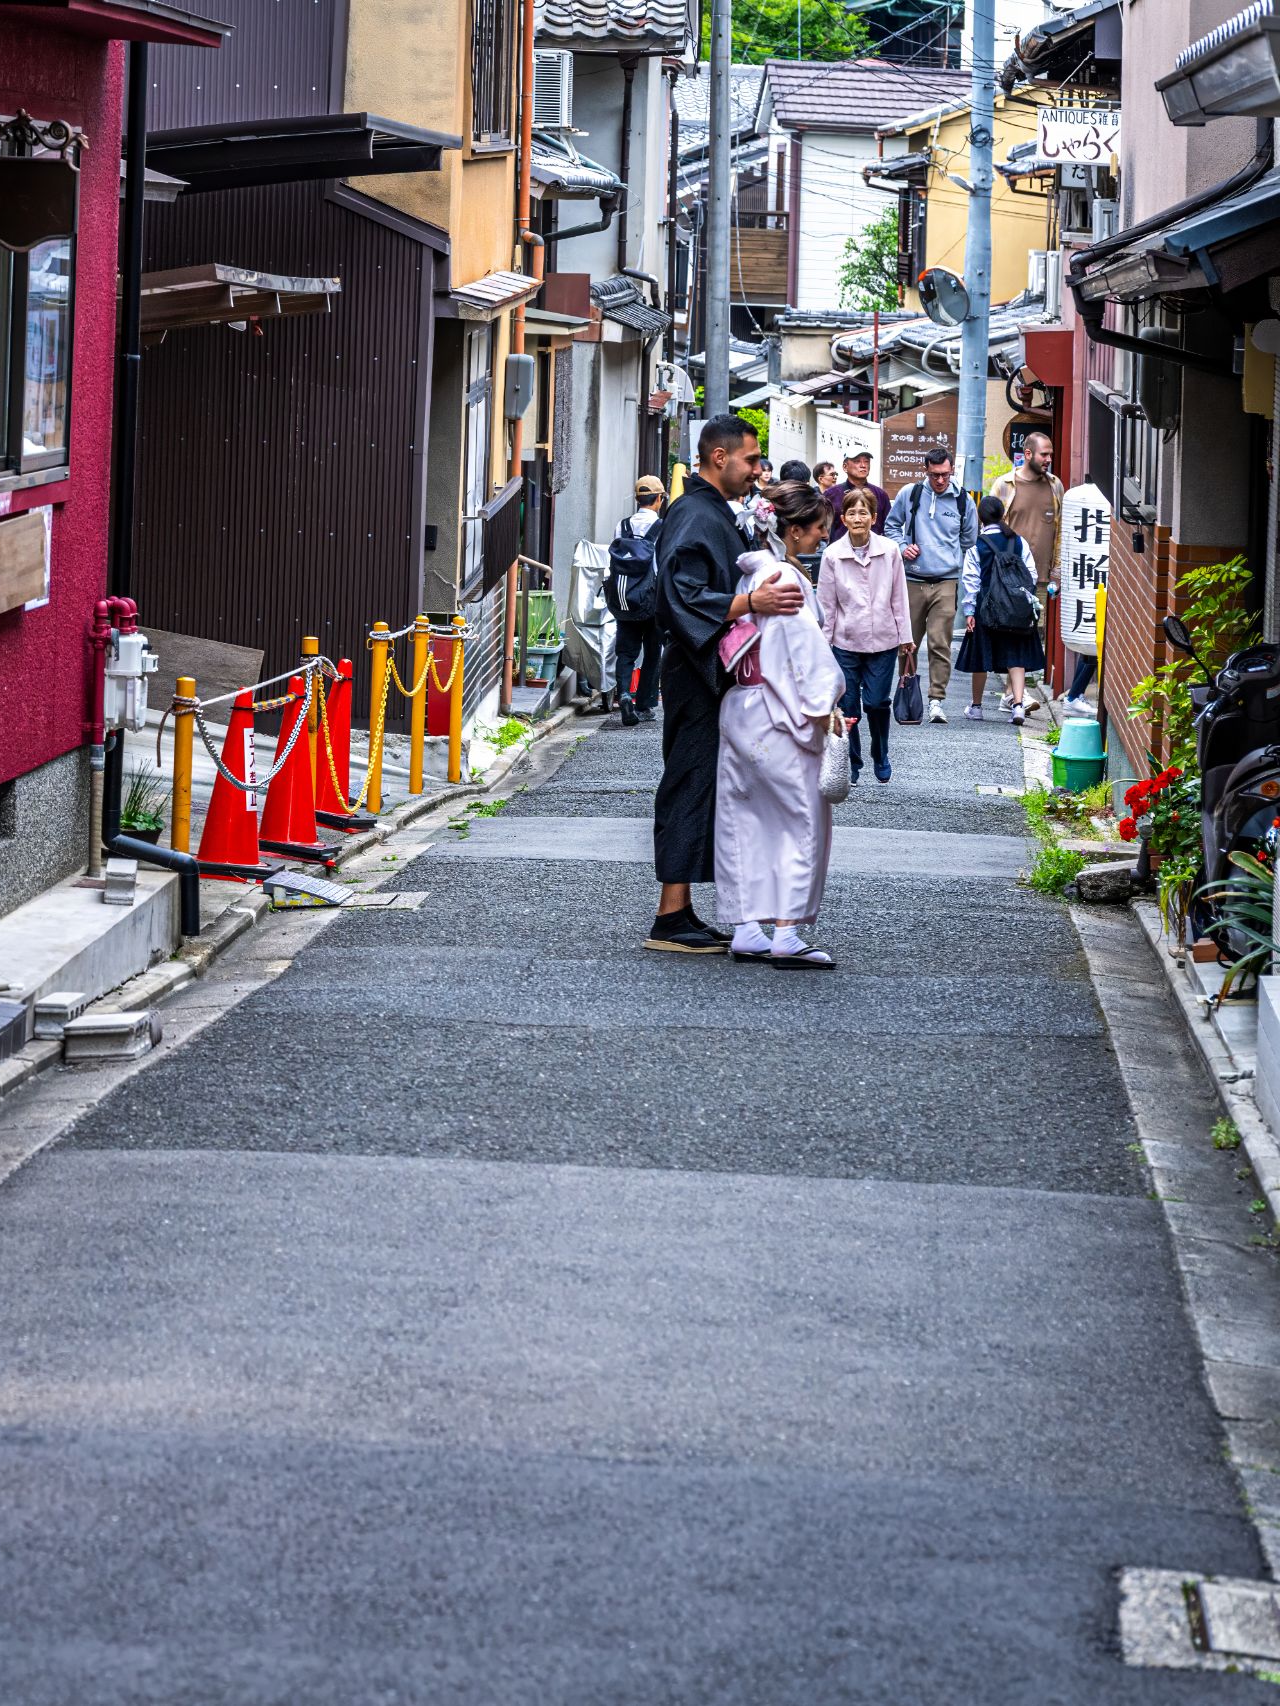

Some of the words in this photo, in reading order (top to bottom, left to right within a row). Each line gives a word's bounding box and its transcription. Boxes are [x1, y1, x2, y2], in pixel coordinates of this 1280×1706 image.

[1041, 109, 1098, 126] ANTIQUES
[1041, 123, 1120, 161] しゃらく
[888, 455, 926, 463] OMOSHI
